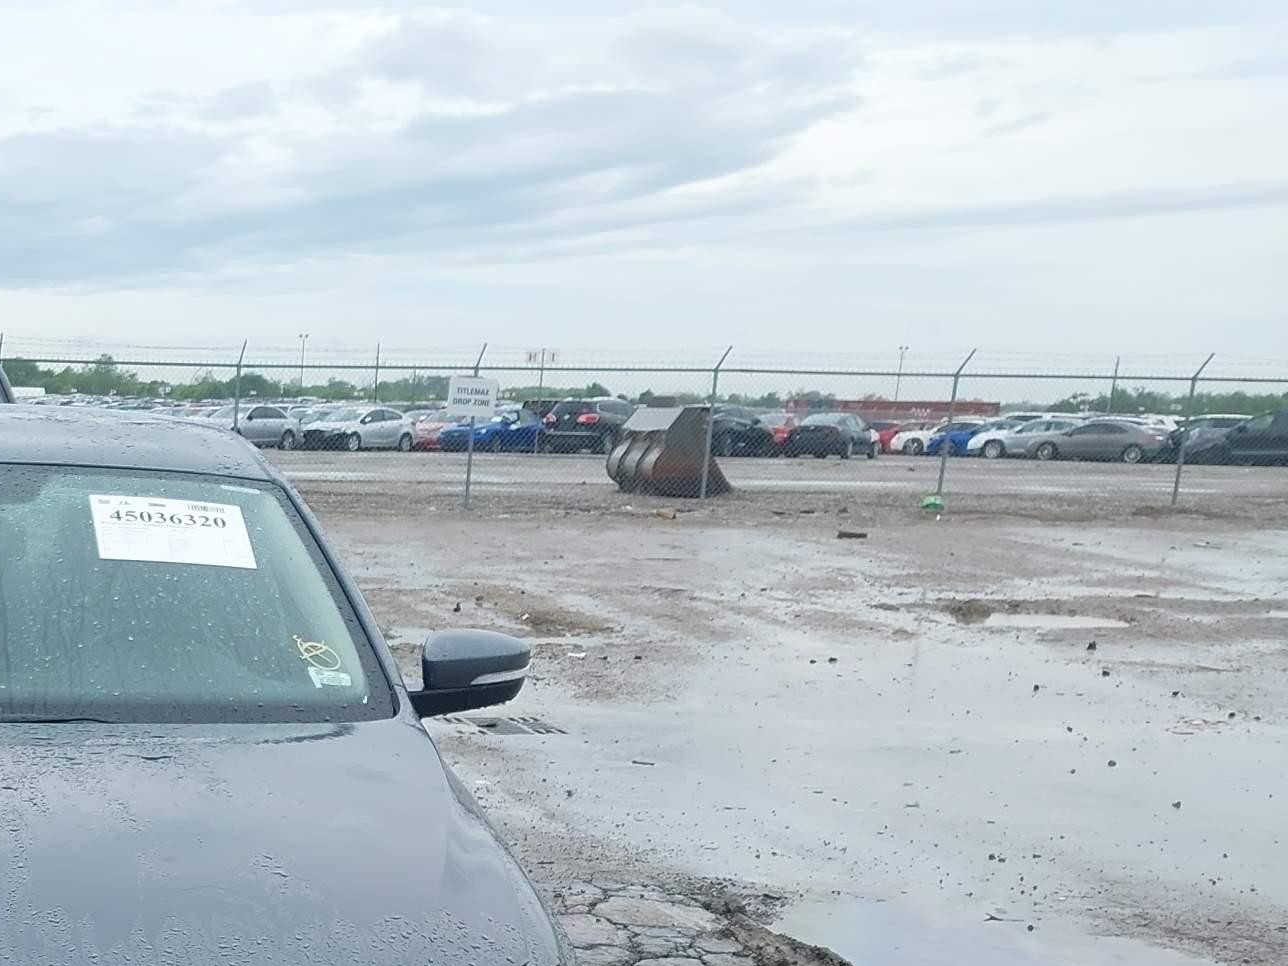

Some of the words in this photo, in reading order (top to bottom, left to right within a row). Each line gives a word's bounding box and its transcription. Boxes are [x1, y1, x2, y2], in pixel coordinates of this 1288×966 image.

[452, 397, 472, 405] DROP
[473, 399, 490, 407] ZONE
[109, 509, 227, 529] 45036320
